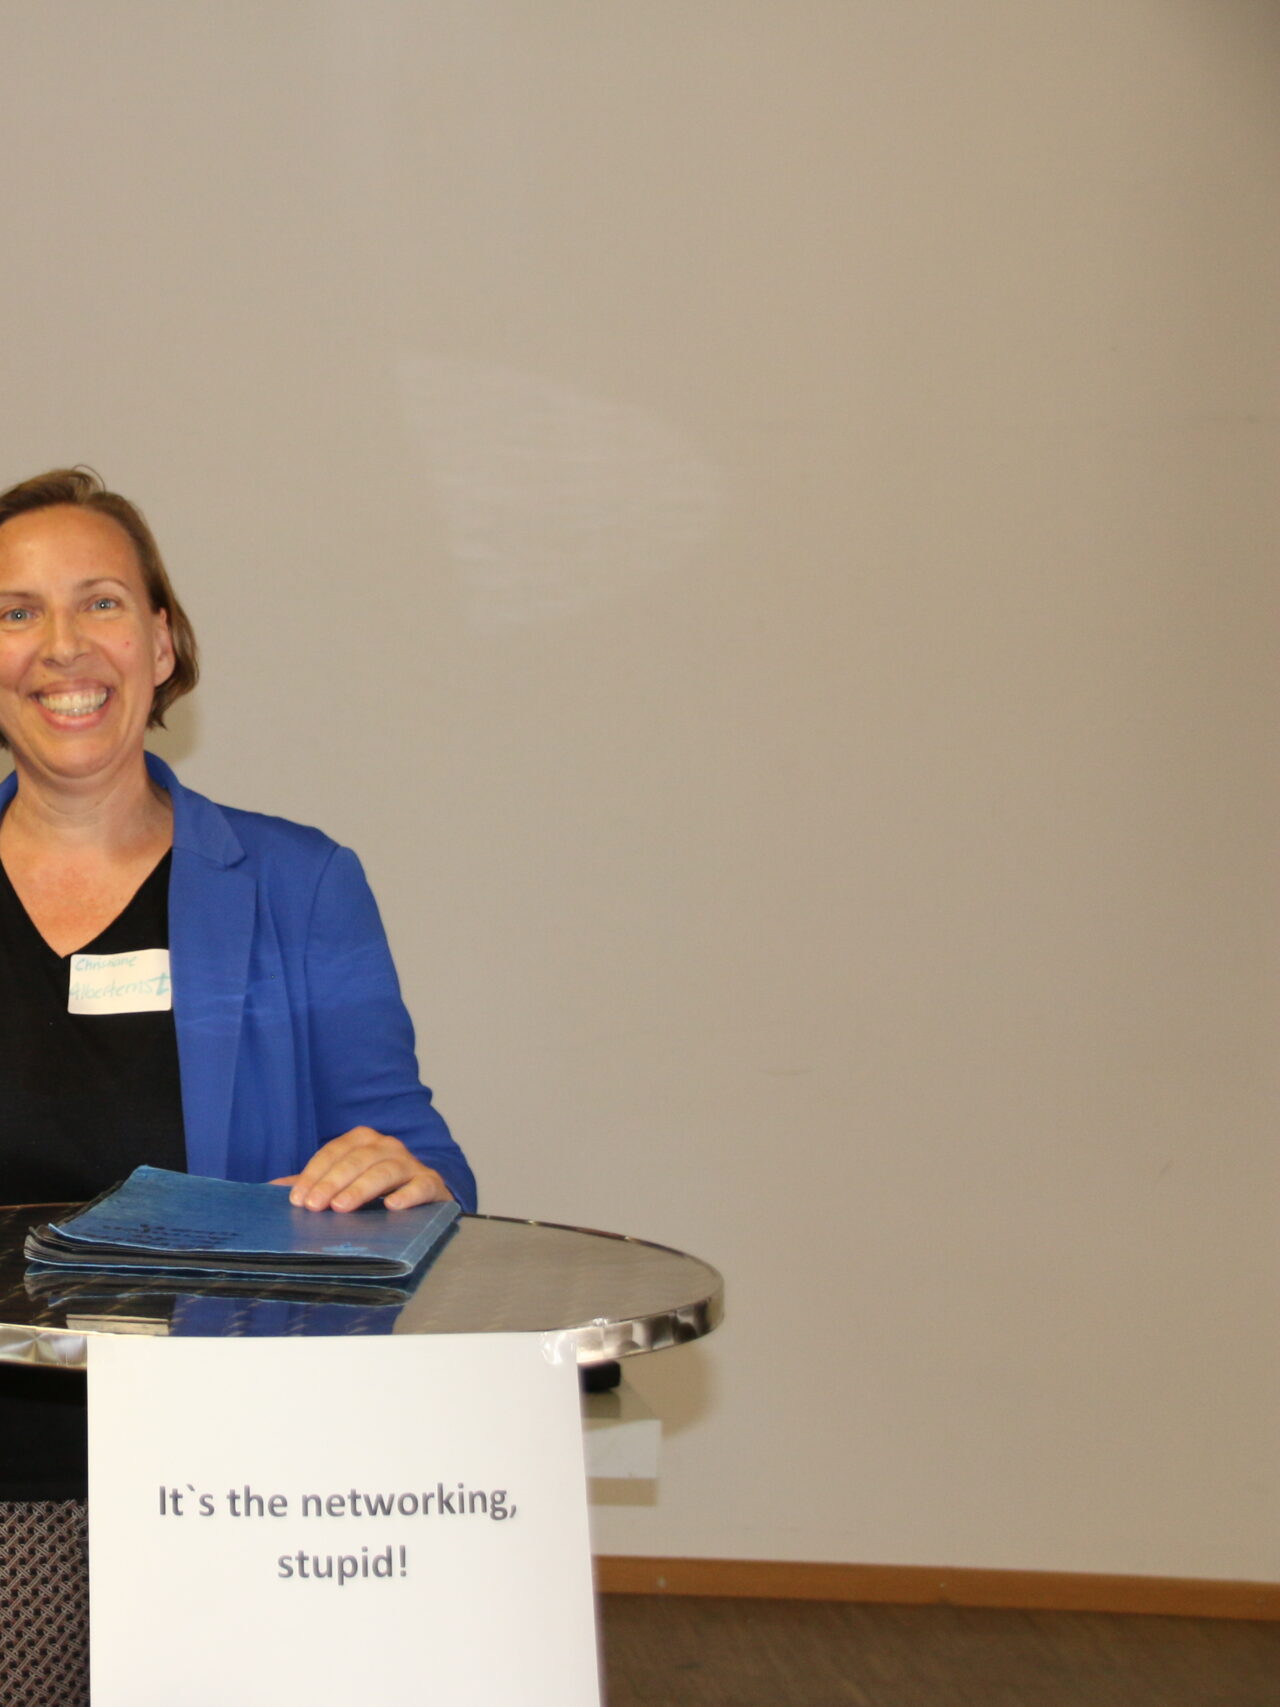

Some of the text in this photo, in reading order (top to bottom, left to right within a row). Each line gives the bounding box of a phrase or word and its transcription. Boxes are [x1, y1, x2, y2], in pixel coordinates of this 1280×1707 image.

[227, 1485, 288, 1517] the
[301, 1483, 517, 1520] networking,
[278, 1545, 407, 1585] stupid!
